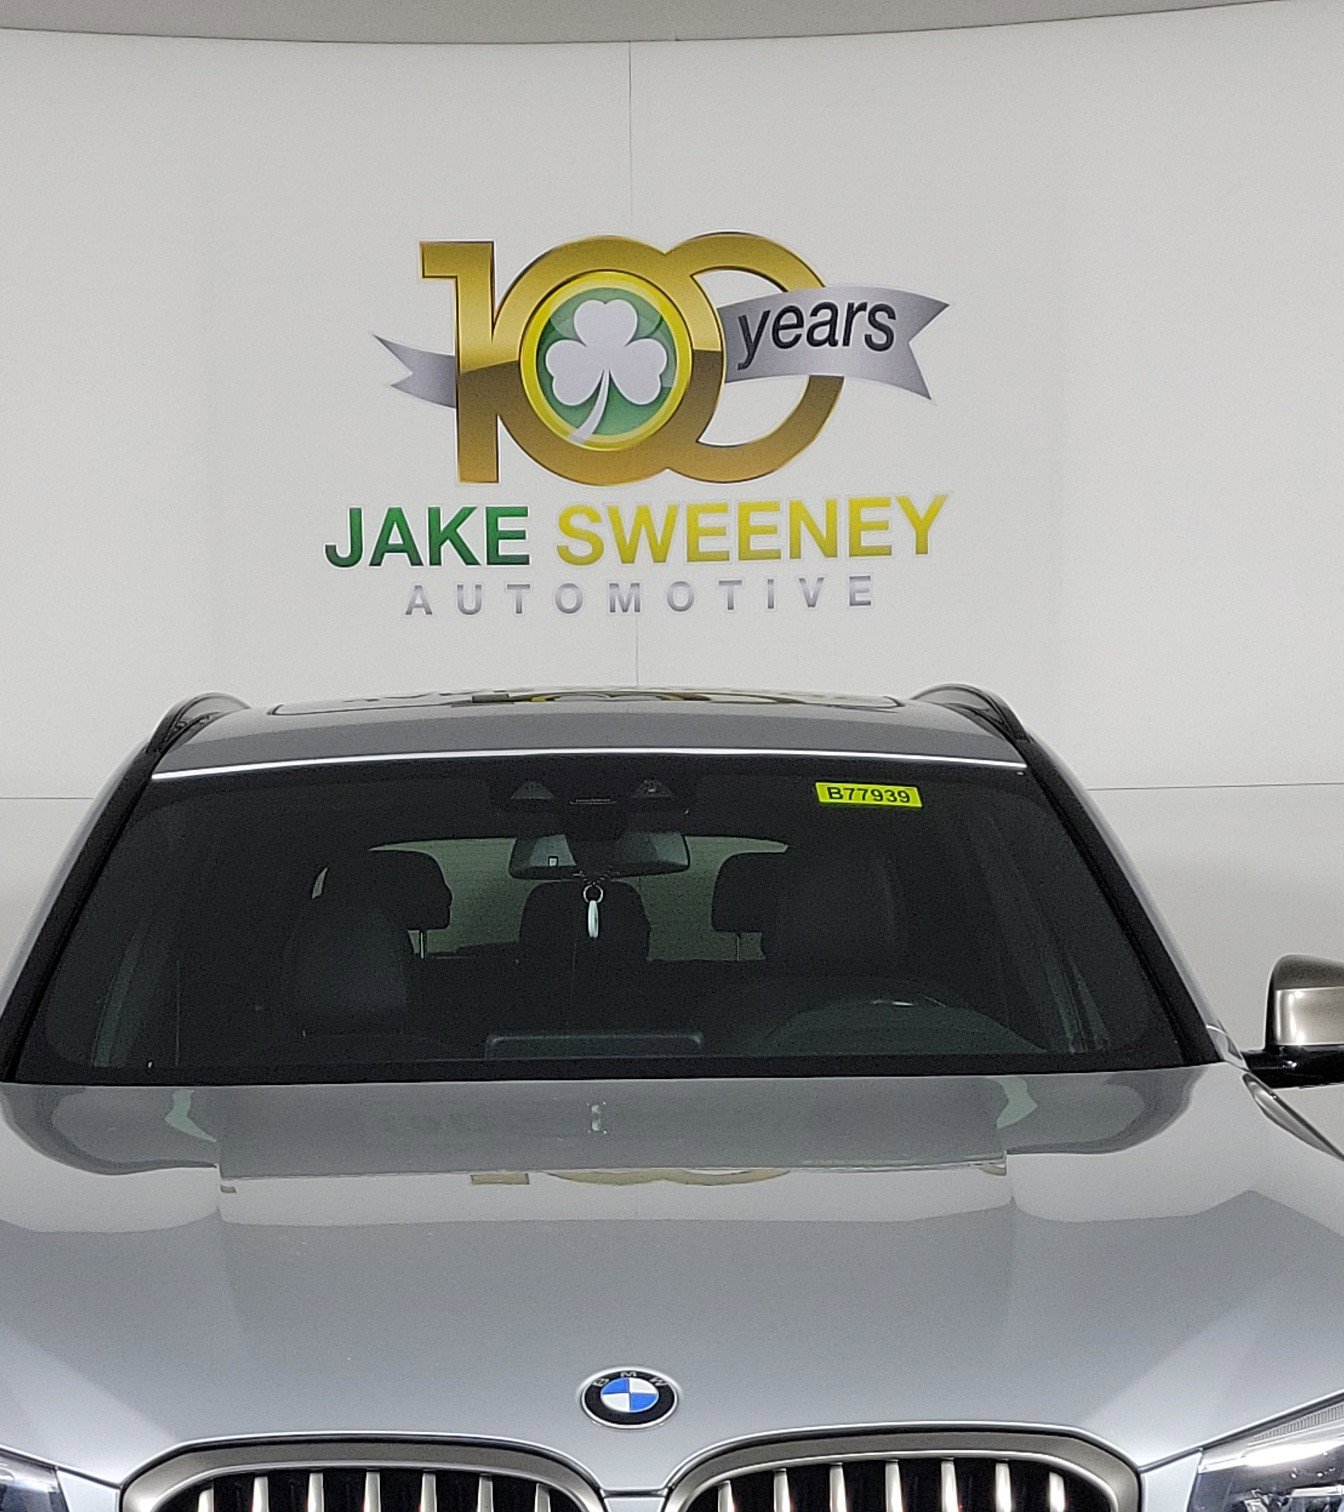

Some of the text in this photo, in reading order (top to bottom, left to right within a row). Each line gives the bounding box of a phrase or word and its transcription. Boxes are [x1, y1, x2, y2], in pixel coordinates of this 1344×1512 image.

[737, 299, 897, 371] years
[324, 493, 950, 568] JAKE SWEENEY
[404, 575, 873, 617] AUTOMOTIVE
[826, 786, 911, 803] B77939
[592, 1370, 668, 1387] BMW
